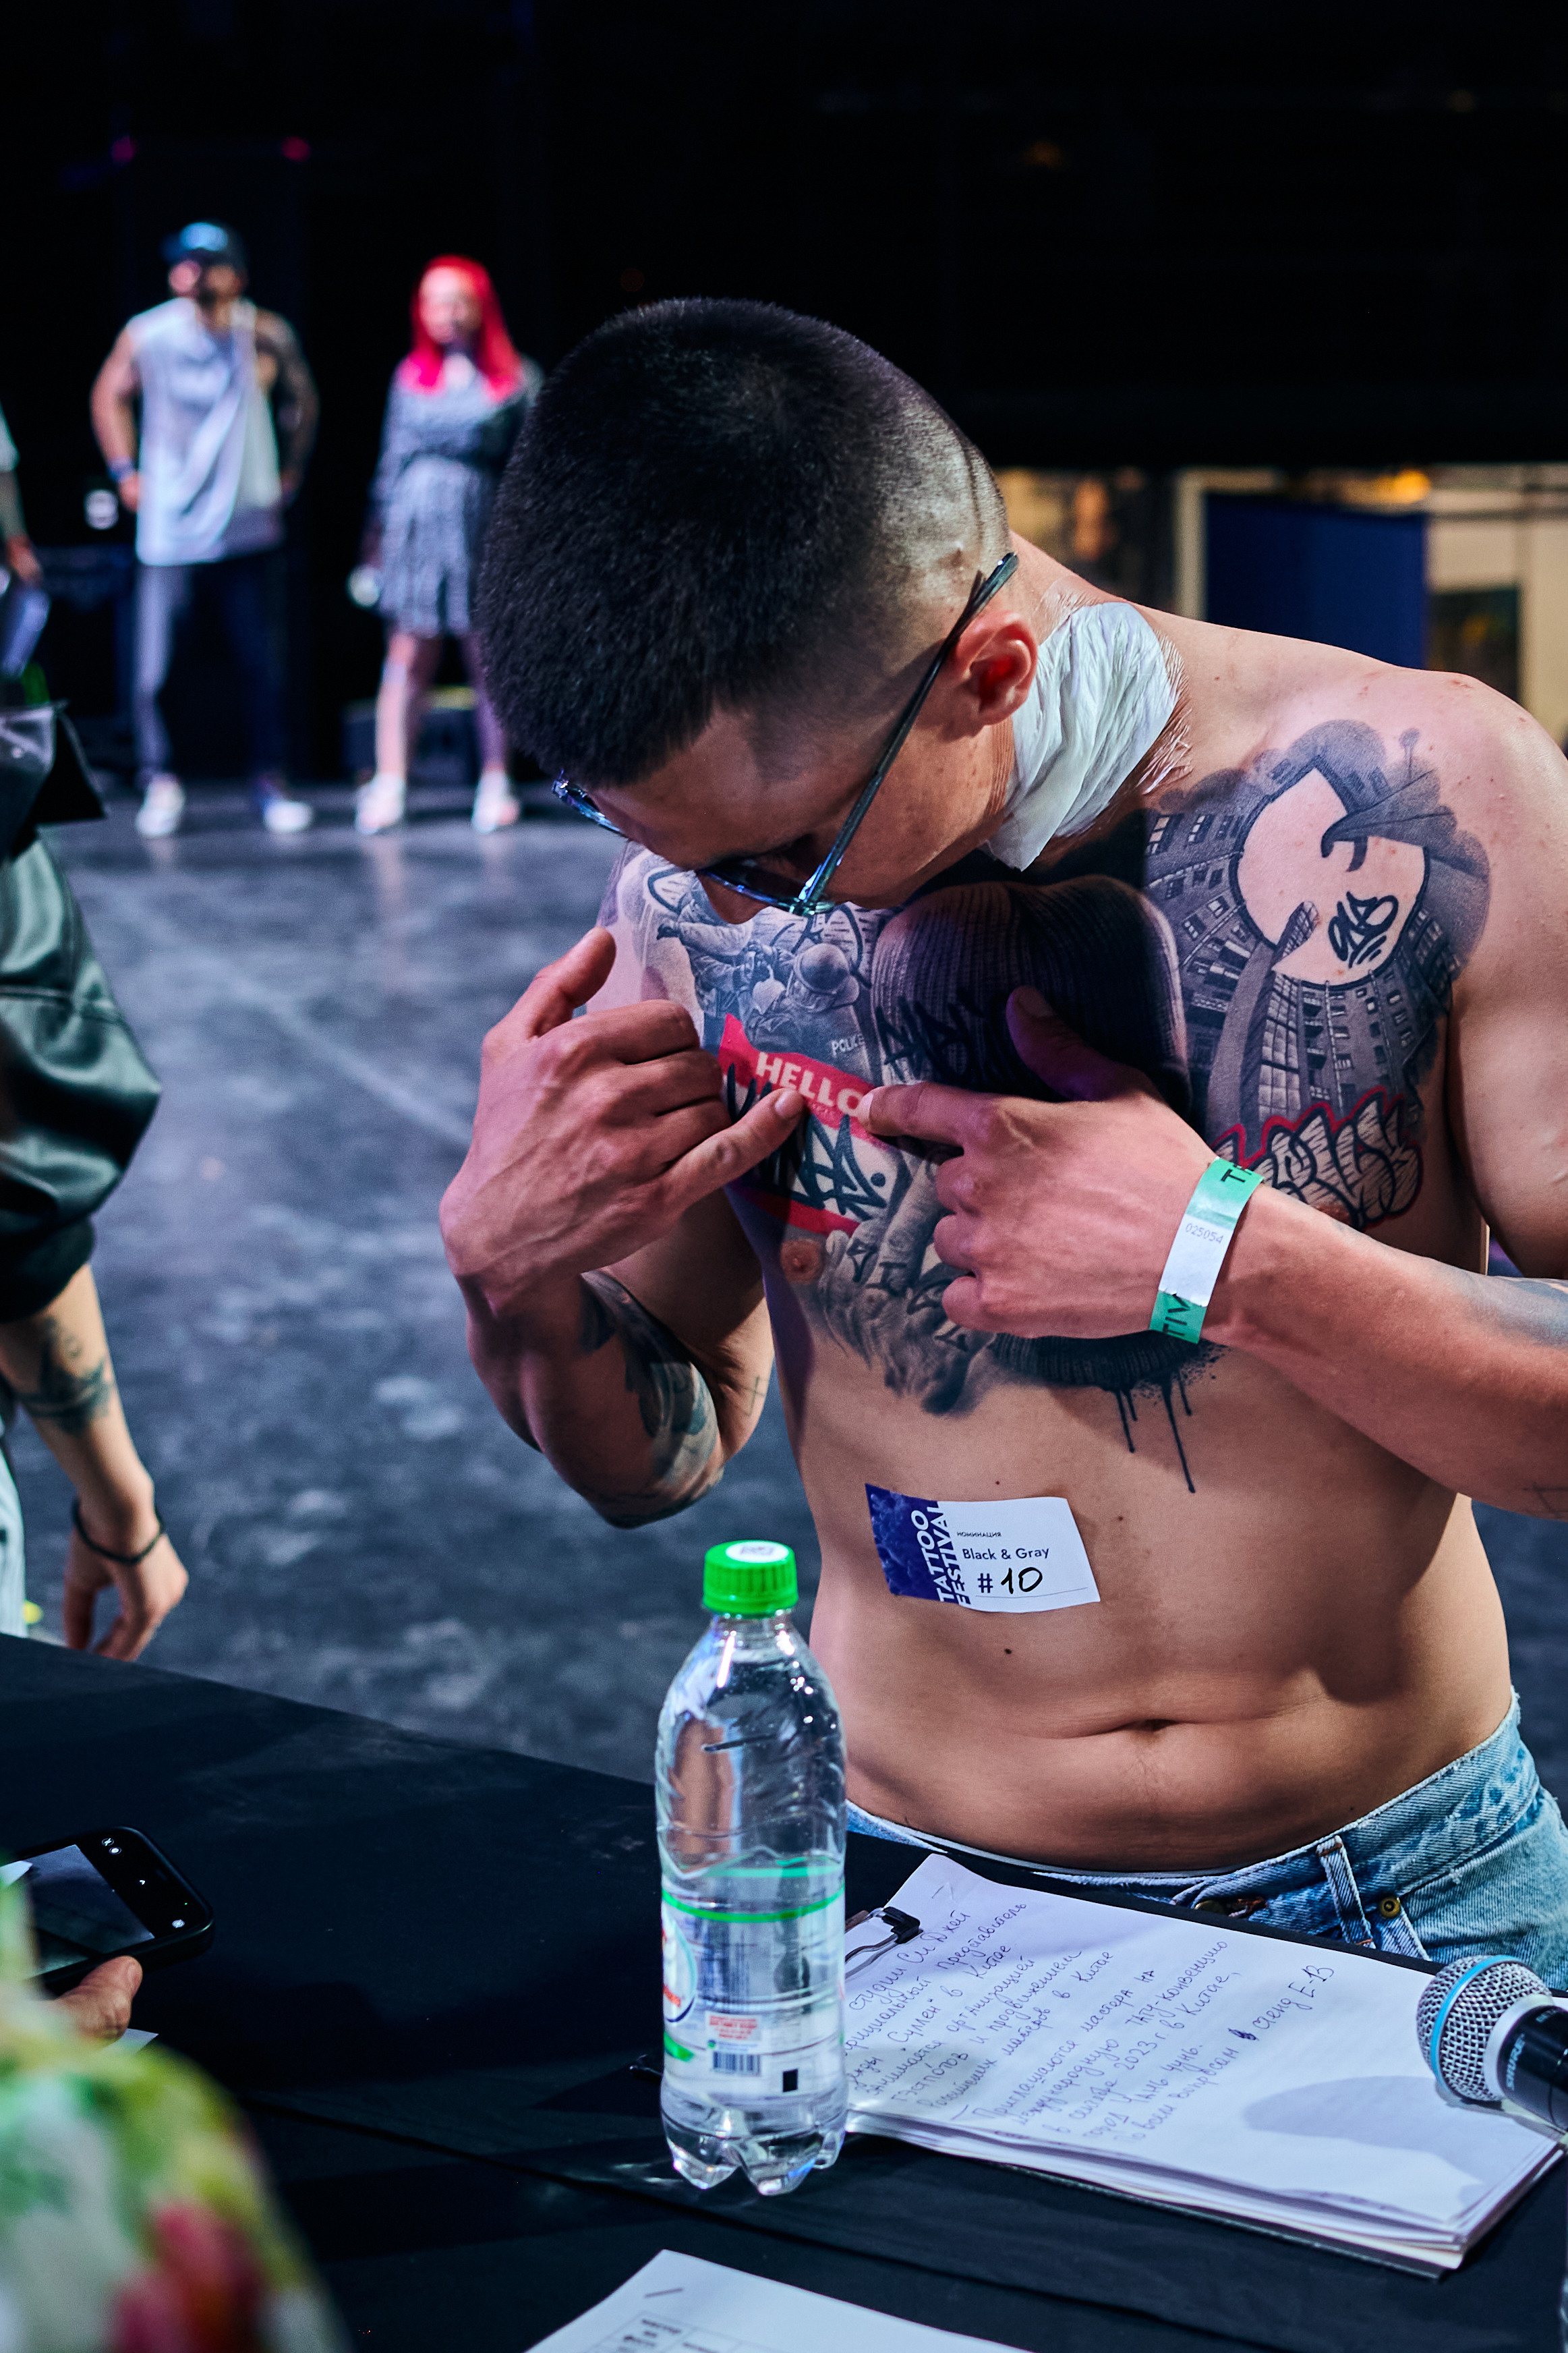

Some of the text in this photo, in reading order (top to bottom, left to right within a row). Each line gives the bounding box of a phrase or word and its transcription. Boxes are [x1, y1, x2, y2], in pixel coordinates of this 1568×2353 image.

[755, 1052, 863, 1117] HELLO
[1186, 1223, 1224, 1244] 025054
[911, 1510, 953, 1602] TATTOO
[927, 1502, 972, 1606] FESTIVAL
[962, 1548, 1049, 1560] Black & Gray
[1113, 2041, 1158, 2070] 2023
[1505, 2040, 1526, 2091] SHURE
